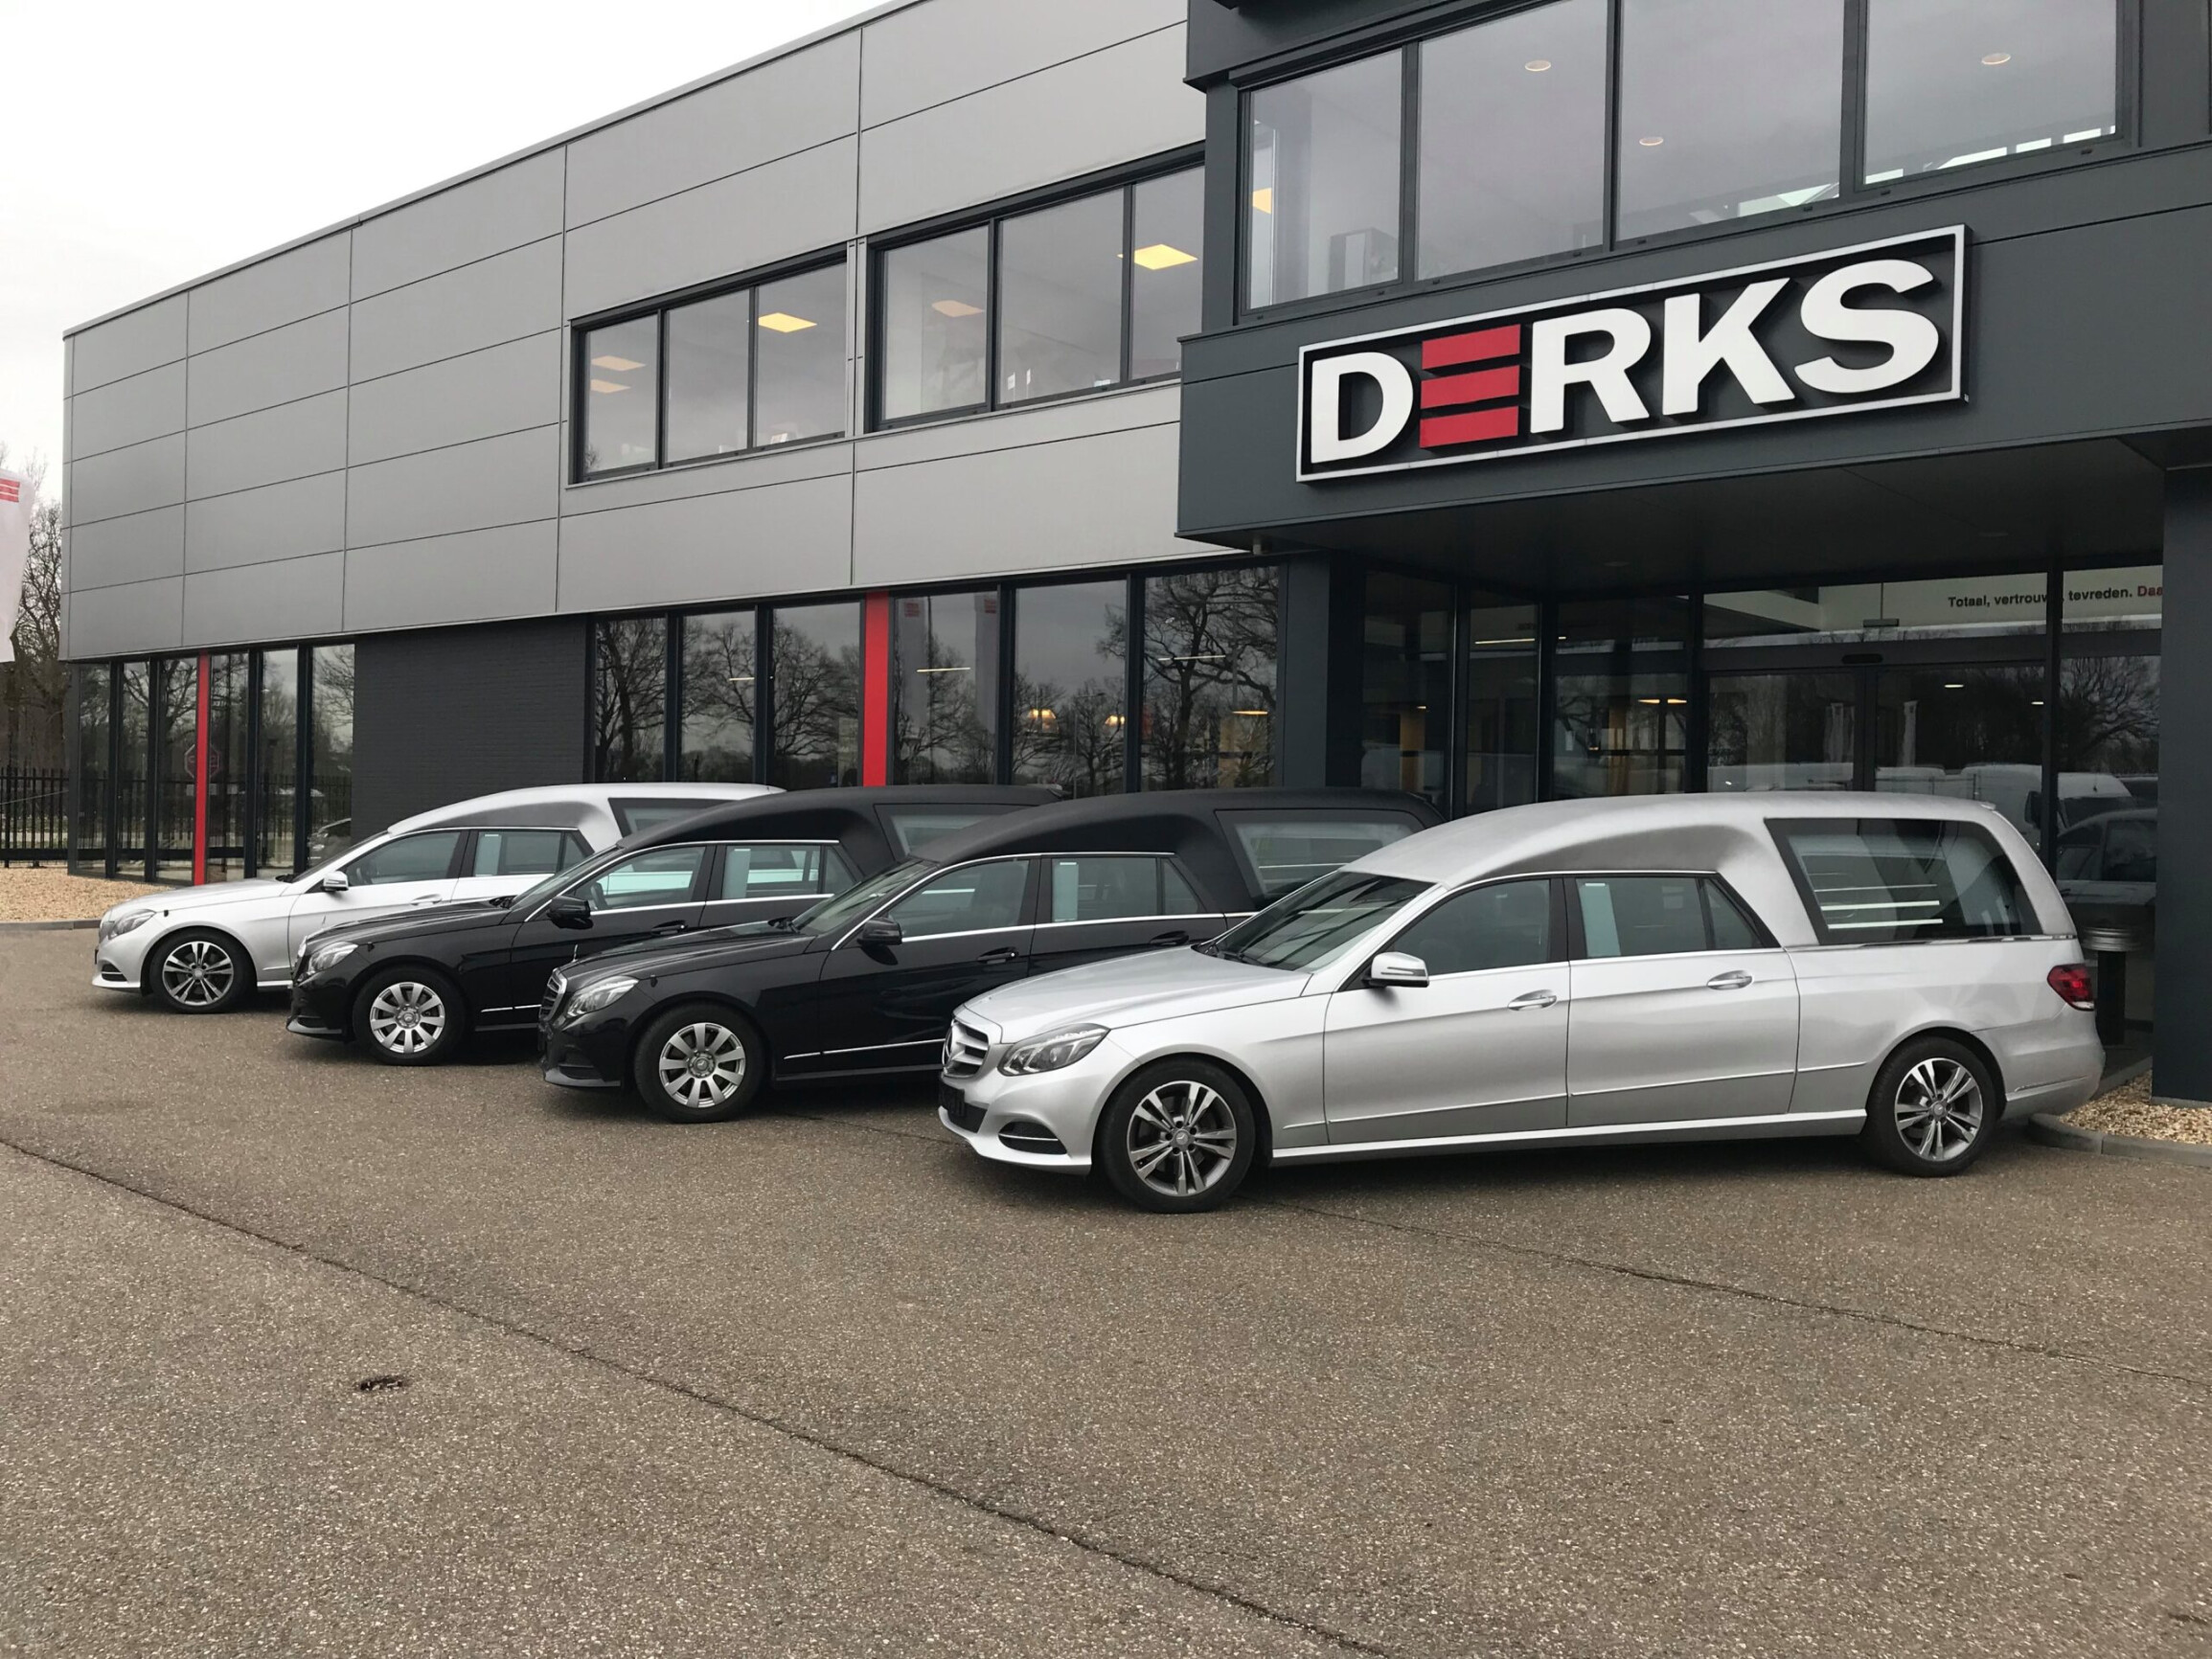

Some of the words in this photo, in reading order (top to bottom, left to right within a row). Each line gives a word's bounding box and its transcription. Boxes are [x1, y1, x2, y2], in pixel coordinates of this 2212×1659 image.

[1311, 259, 1940, 464] DERKS
[1948, 595, 1991, 608] Totaal,
[2068, 587, 2133, 602] tevreden.
